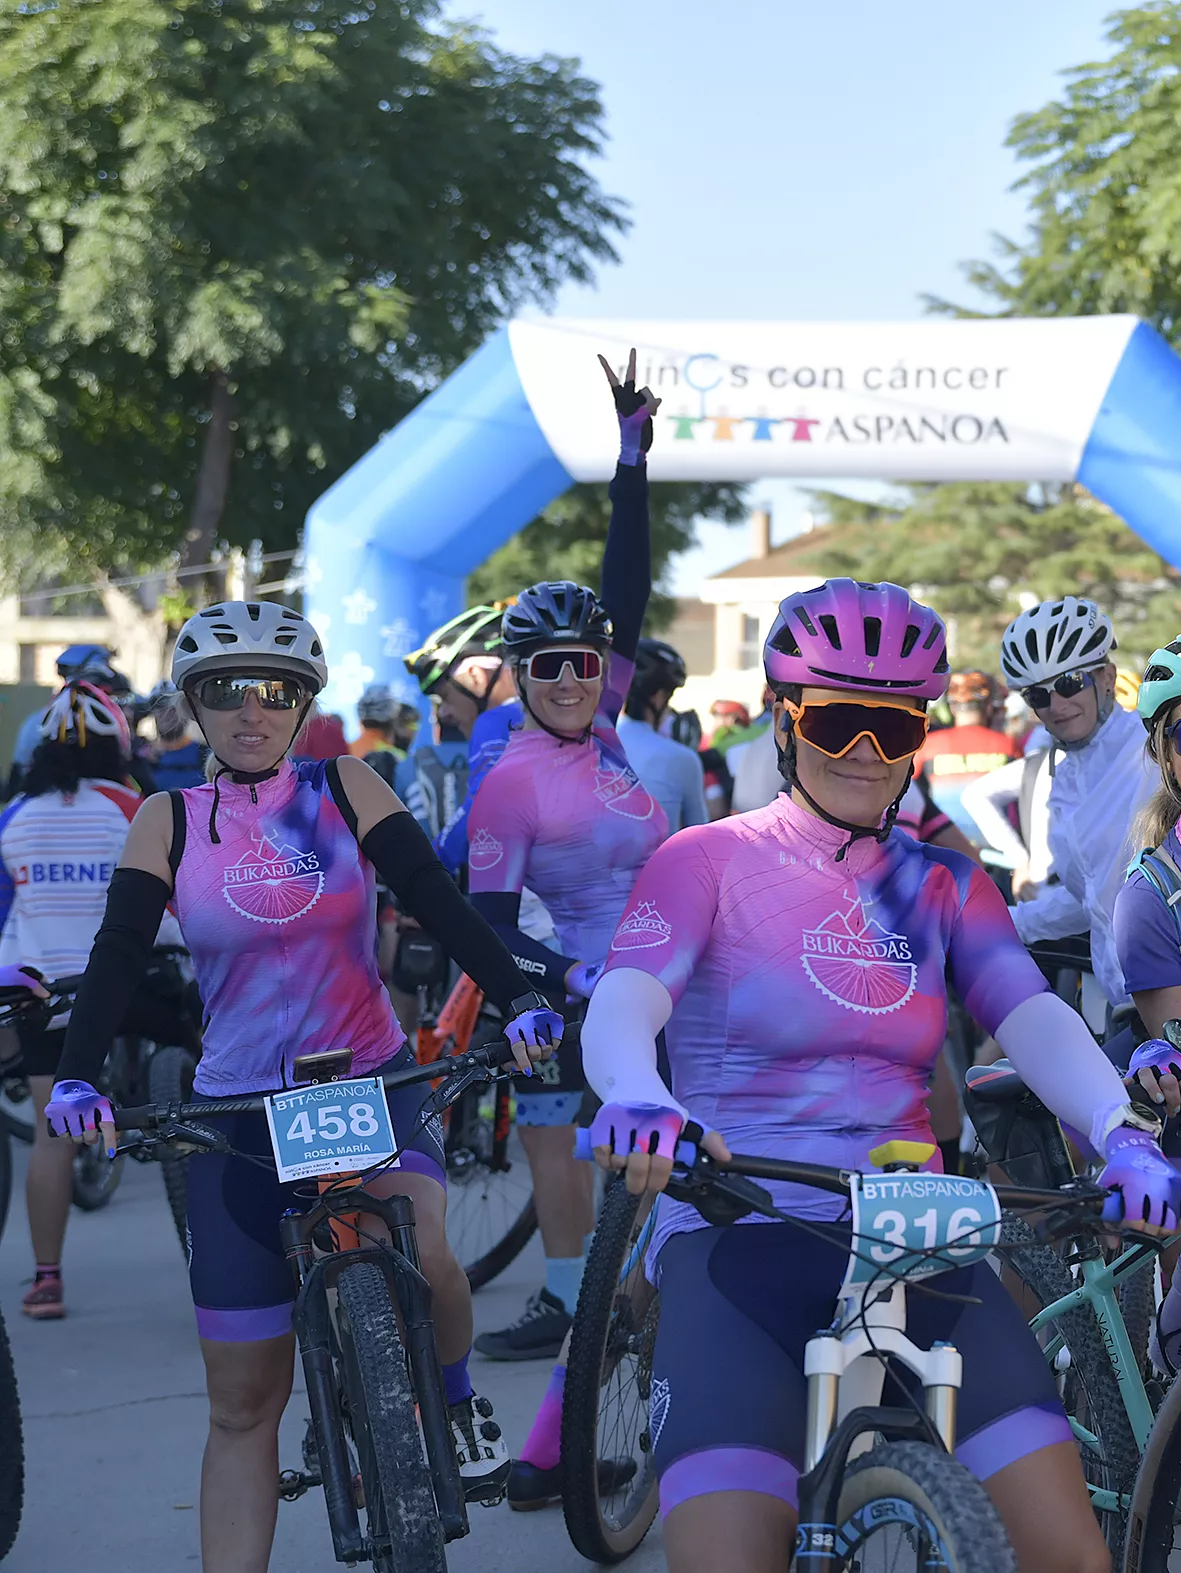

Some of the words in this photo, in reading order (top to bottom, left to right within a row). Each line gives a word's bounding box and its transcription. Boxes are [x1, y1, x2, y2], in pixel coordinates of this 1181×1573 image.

[767, 366, 844, 389] con
[863, 360, 1009, 390] cáncer
[826, 414, 1011, 444] ASPANOA
[32, 861, 119, 884] BERNE
[223, 854, 320, 884] BUKARDAS
[802, 933, 913, 960] BUKARDAS
[275, 1084, 377, 1111] BTTASPANOA
[286, 1102, 379, 1144] 458
[304, 1148, 335, 1160] ROSA
[336, 1142, 371, 1155] MARÍA
[863, 1180, 987, 1200] BTTASPANOA
[870, 1207, 983, 1263] 316
[812, 1533, 834, 1547] 32
